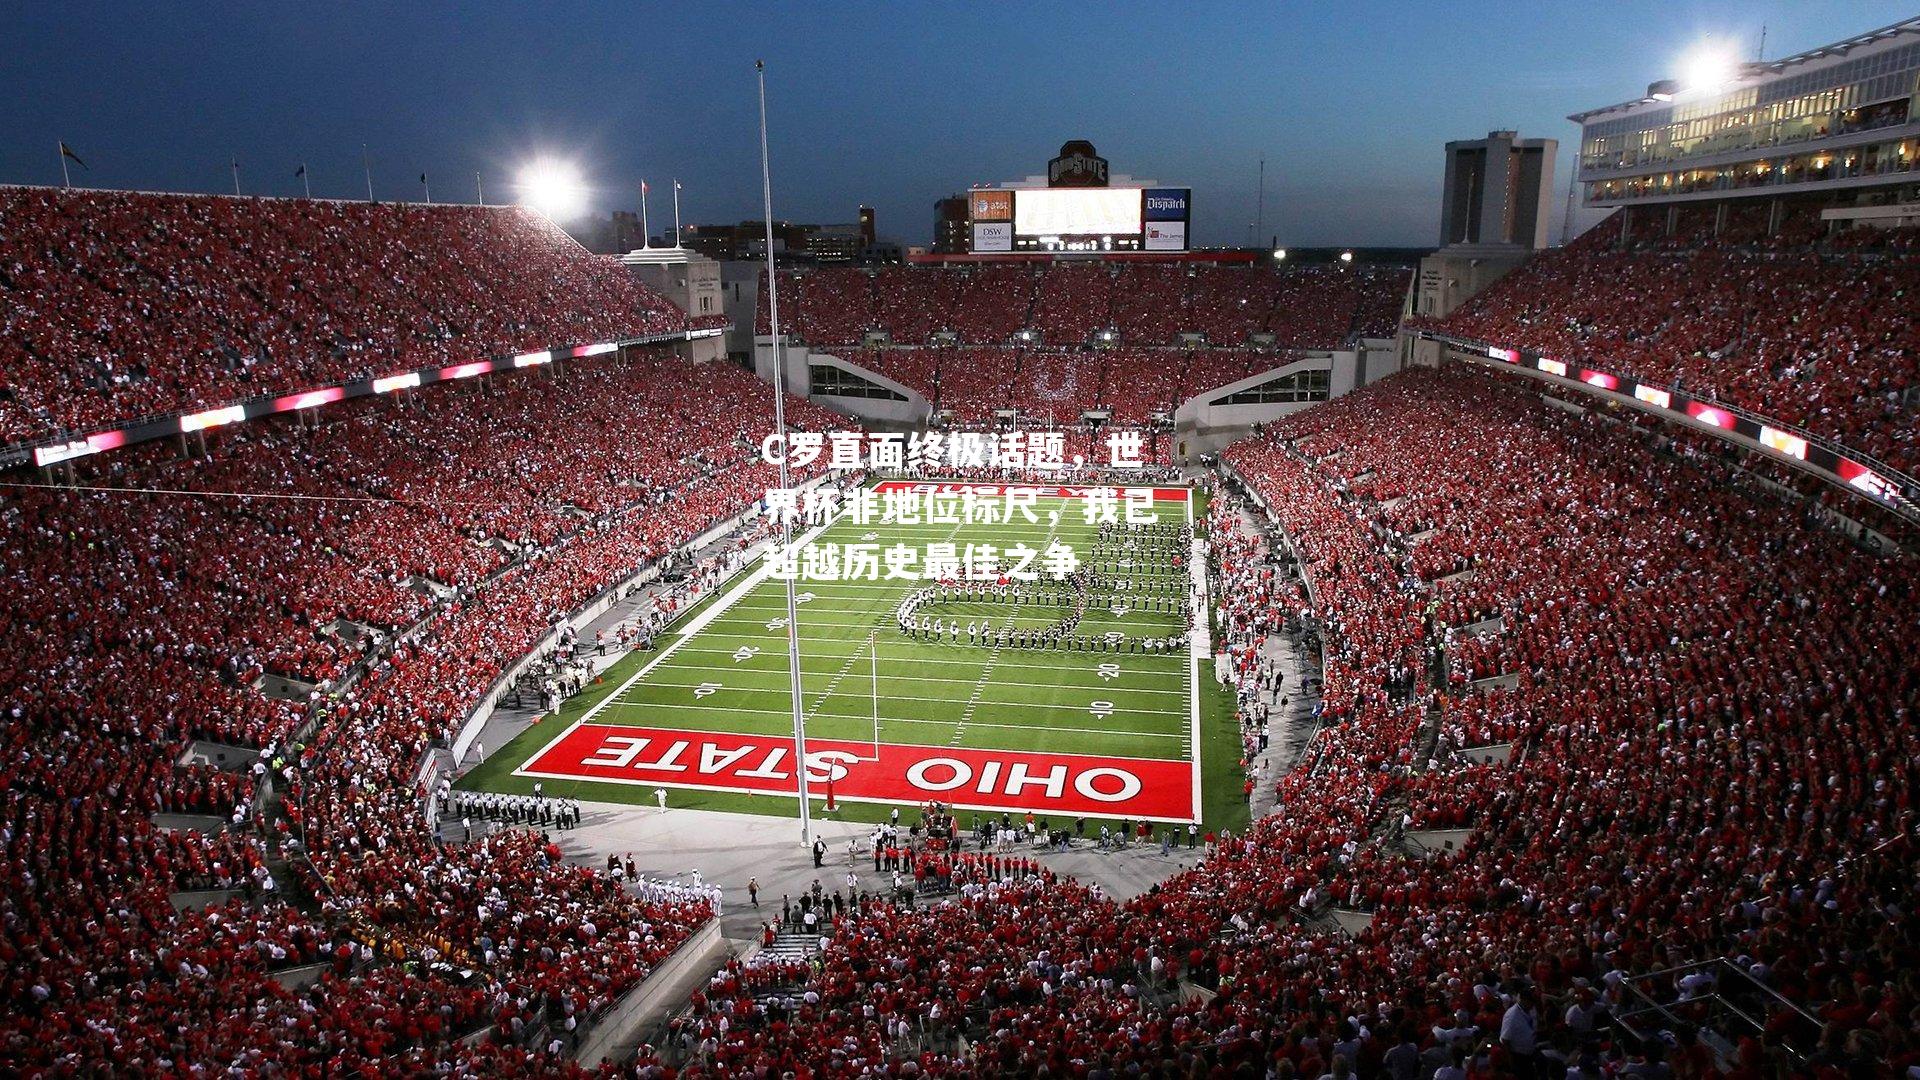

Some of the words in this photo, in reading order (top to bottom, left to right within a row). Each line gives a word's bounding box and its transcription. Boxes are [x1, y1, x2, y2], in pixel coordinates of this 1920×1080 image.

[1147, 197, 1186, 211] Dispatch
[983, 228, 1002, 236] DSW
[1098, 663, 1120, 678] 20
[694, 682, 723, 695] 10
[1089, 701, 1114, 715] 10
[580, 736, 859, 784] STATE
[906, 757, 1142, 802] OHIO
